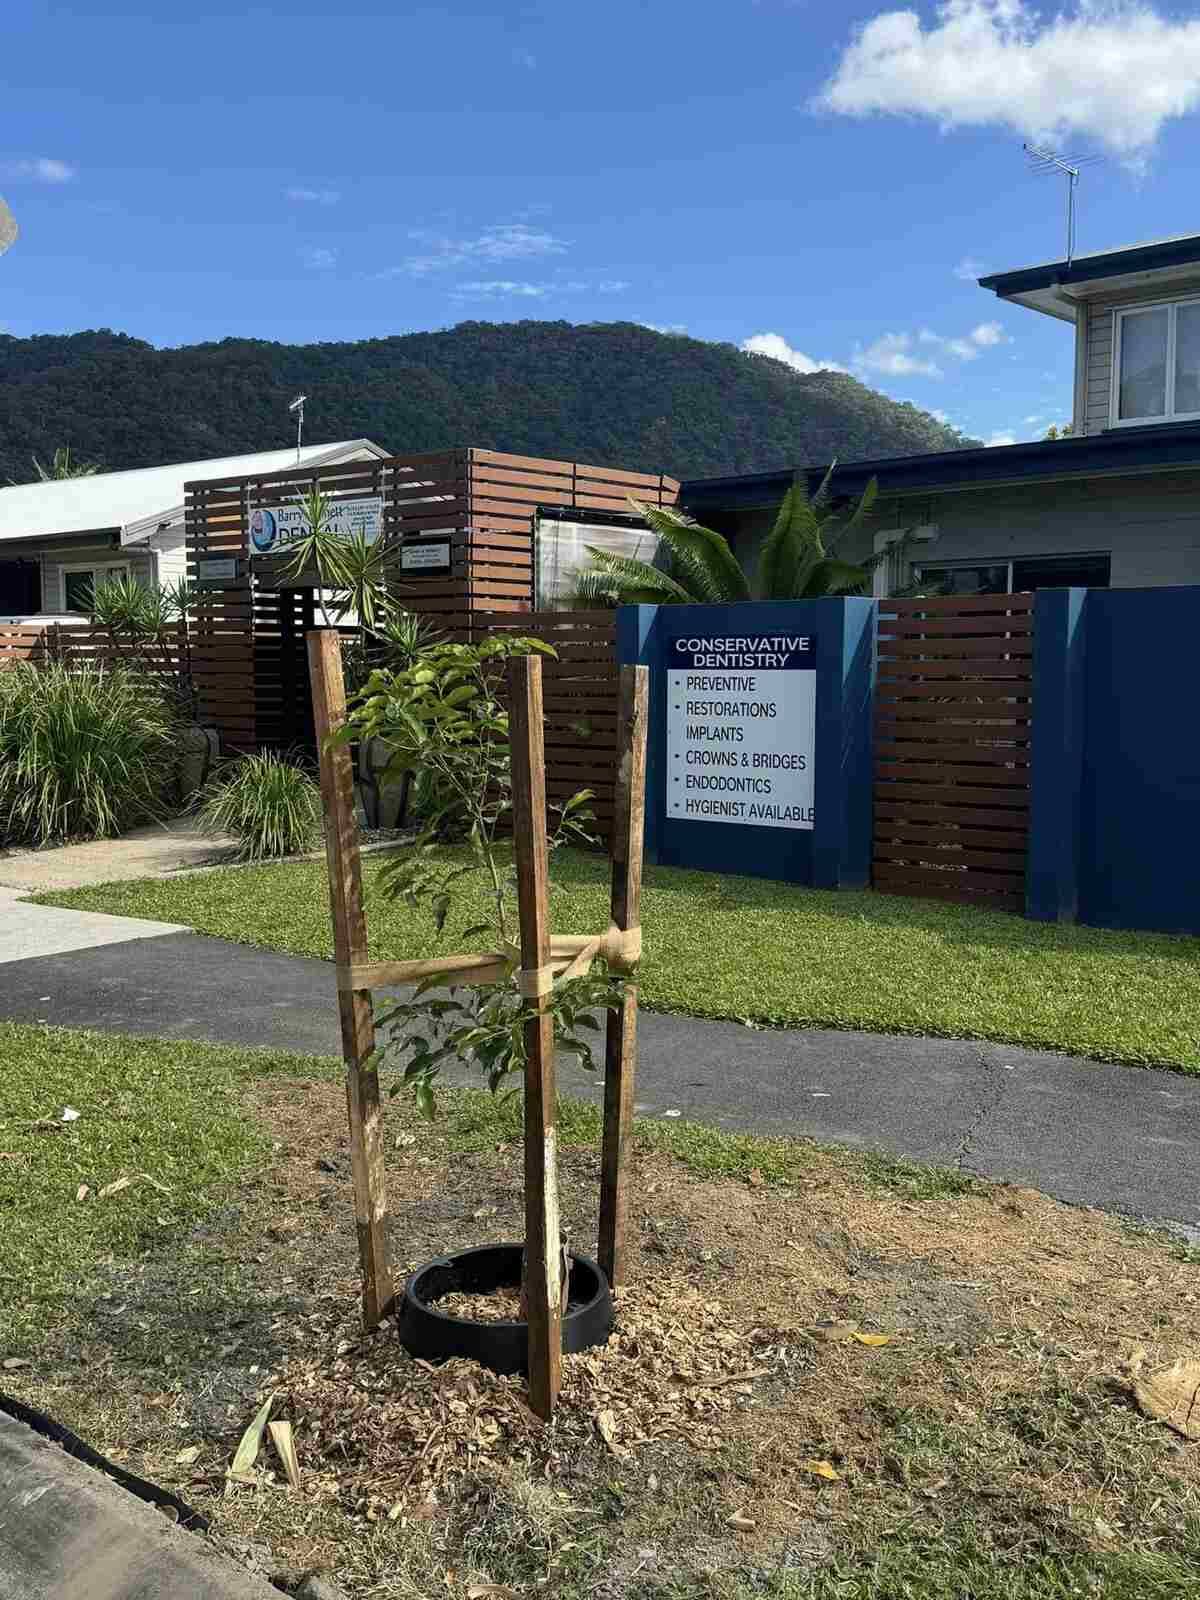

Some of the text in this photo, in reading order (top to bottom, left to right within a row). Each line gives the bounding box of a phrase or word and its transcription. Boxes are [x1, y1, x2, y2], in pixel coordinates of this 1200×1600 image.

[675, 637, 810, 652] CONSERVATIVE
[693, 653, 790, 667] DENTISTRY
[687, 676, 757, 691] PREVENTIVE
[686, 701, 777, 718] RESTORATIONS
[686, 725, 744, 742] IMPLANTS
[686, 750, 807, 770] CROWNS & BRIDGES
[686, 774, 772, 794] ENDODONTICS
[686, 798, 816, 823] HYGIENIST AVAILABLE
